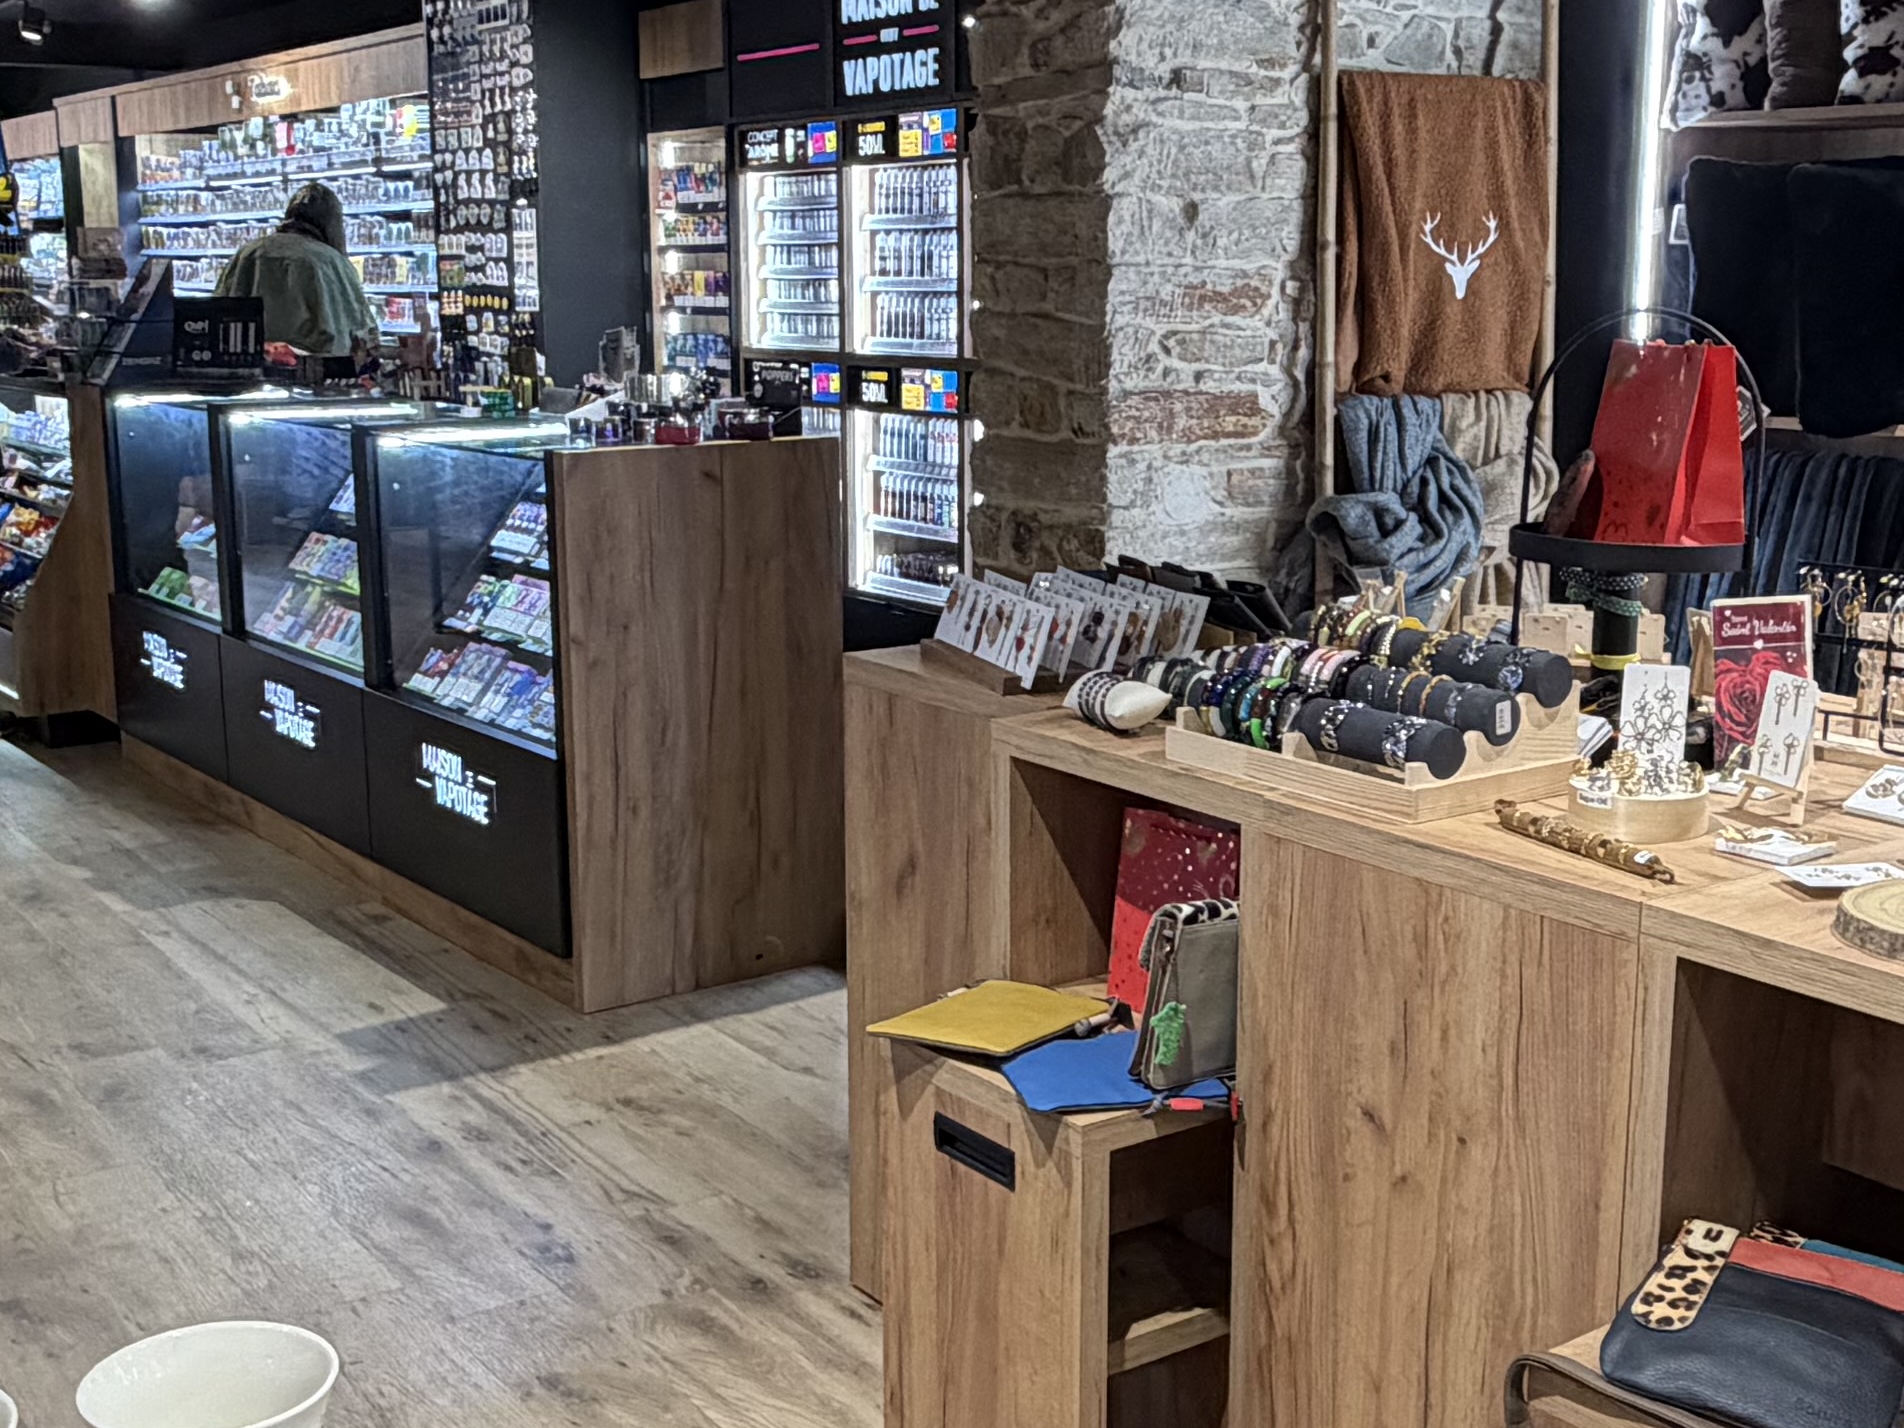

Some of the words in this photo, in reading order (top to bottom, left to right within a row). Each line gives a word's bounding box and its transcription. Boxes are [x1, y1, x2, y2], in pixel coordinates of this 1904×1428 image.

[842, 47, 940, 97] VAPOTAGE
[421, 742, 463, 783] MAISON
[434, 775, 490, 824] VAPOTAGE
